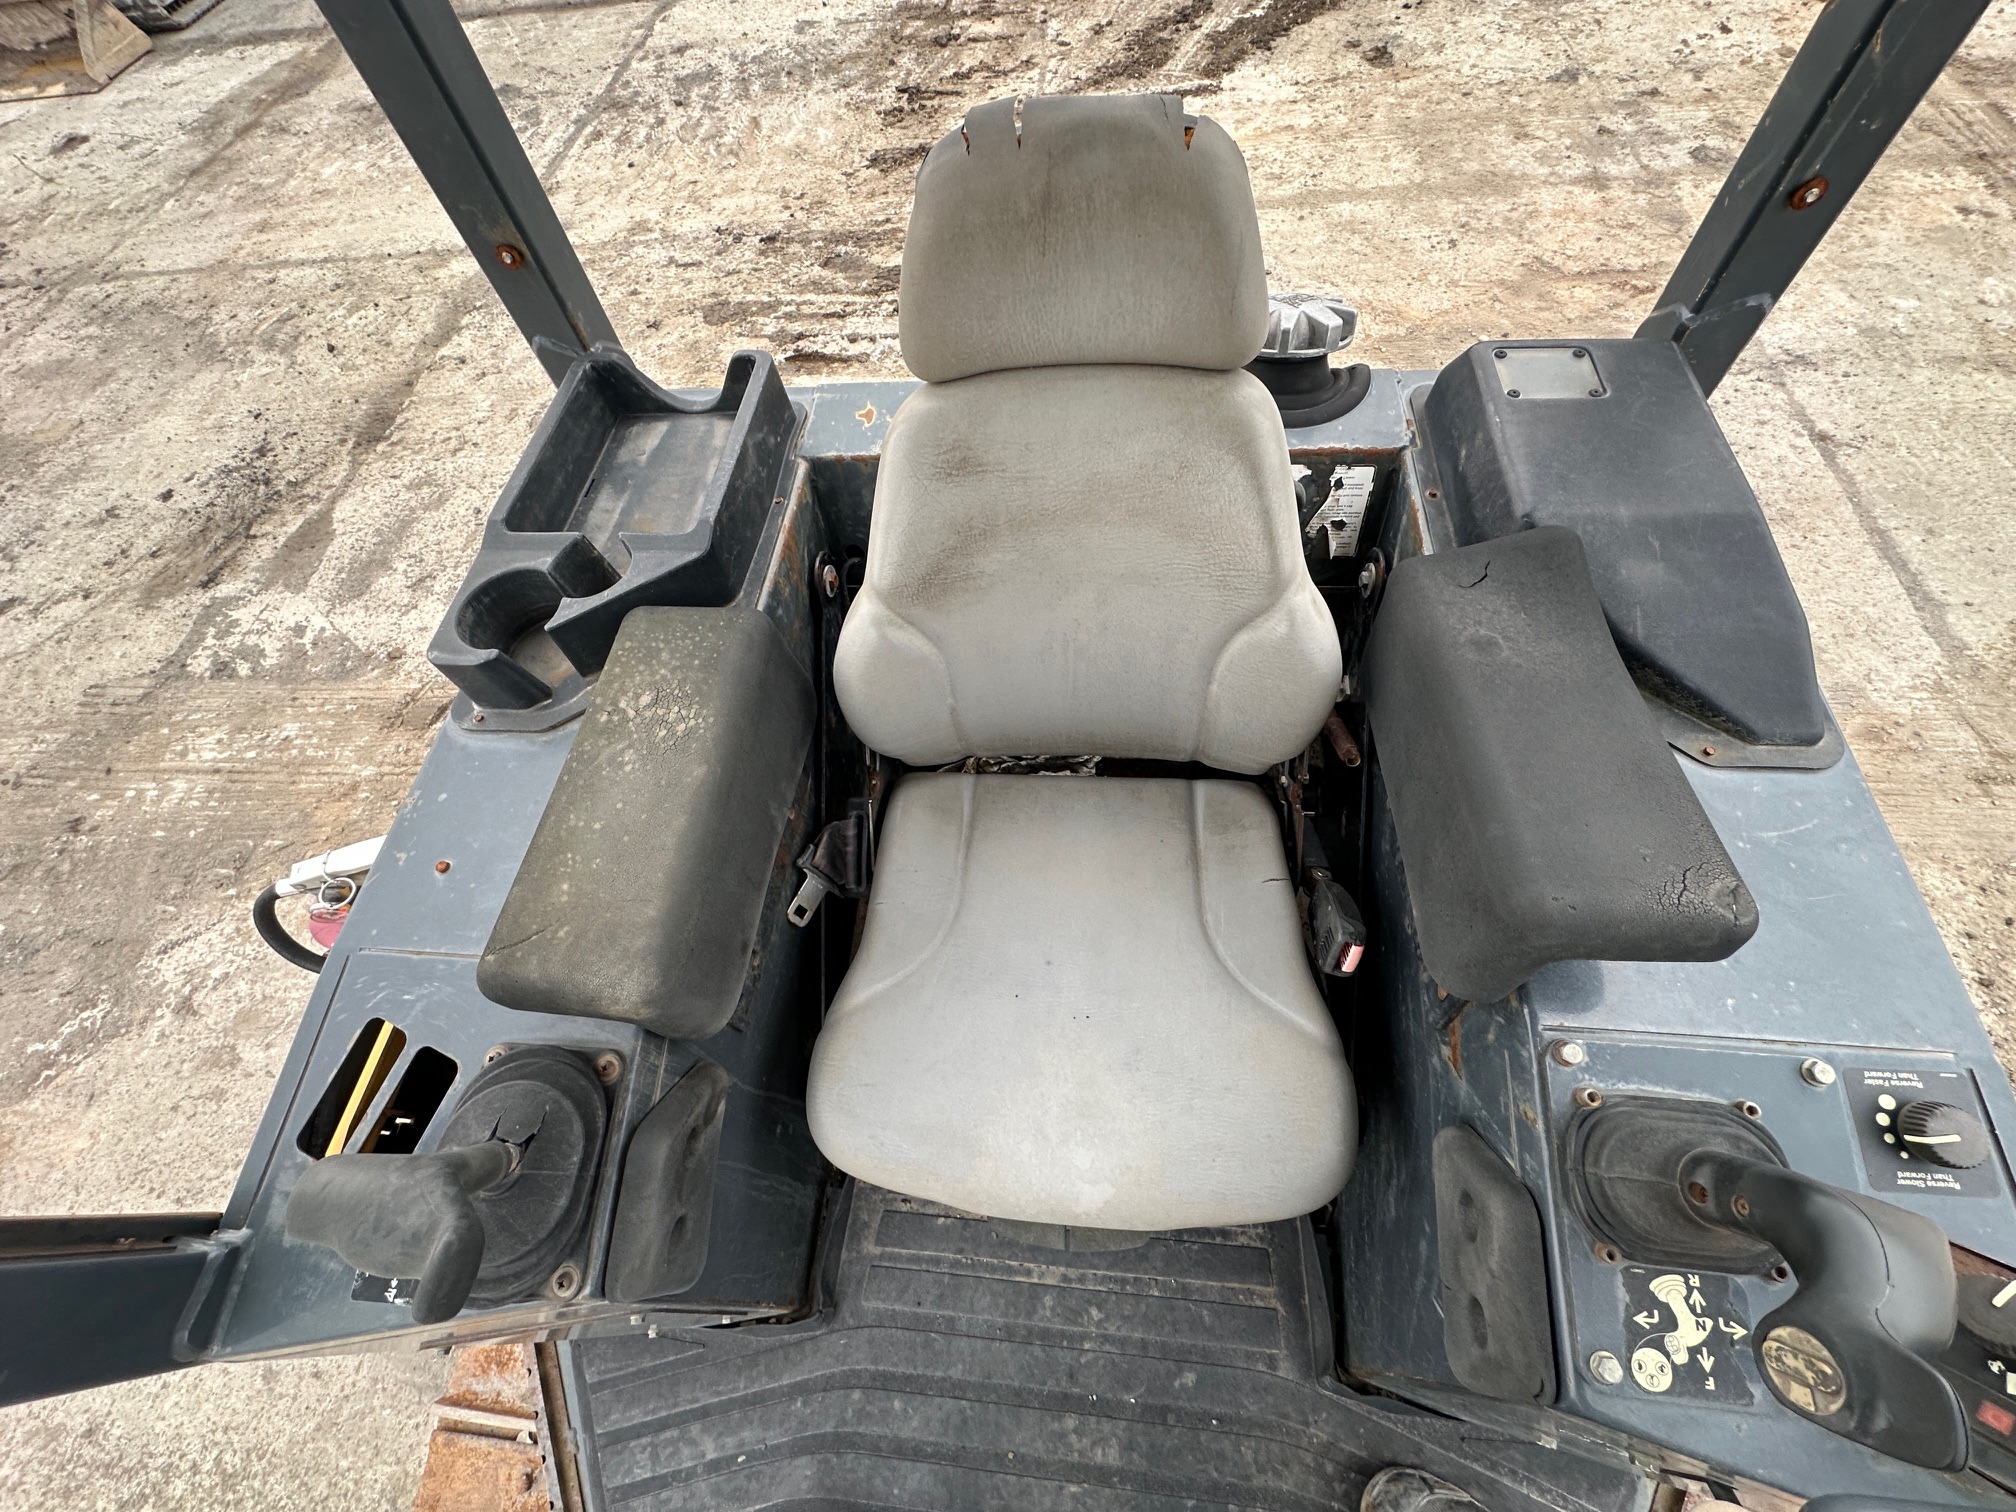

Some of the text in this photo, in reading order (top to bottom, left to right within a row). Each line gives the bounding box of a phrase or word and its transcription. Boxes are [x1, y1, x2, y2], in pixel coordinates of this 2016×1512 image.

[1864, 1070, 1919, 1081] Than Forward
[1864, 1078, 1923, 1089] Reverse Faster
[1897, 1171, 1955, 1182] Than Forward
[1896, 1178, 1961, 1190] Reverse Slower
[1687, 1273, 1700, 1287] R
[1695, 1318, 1707, 1332] N
[1704, 1376, 1715, 1391] F
